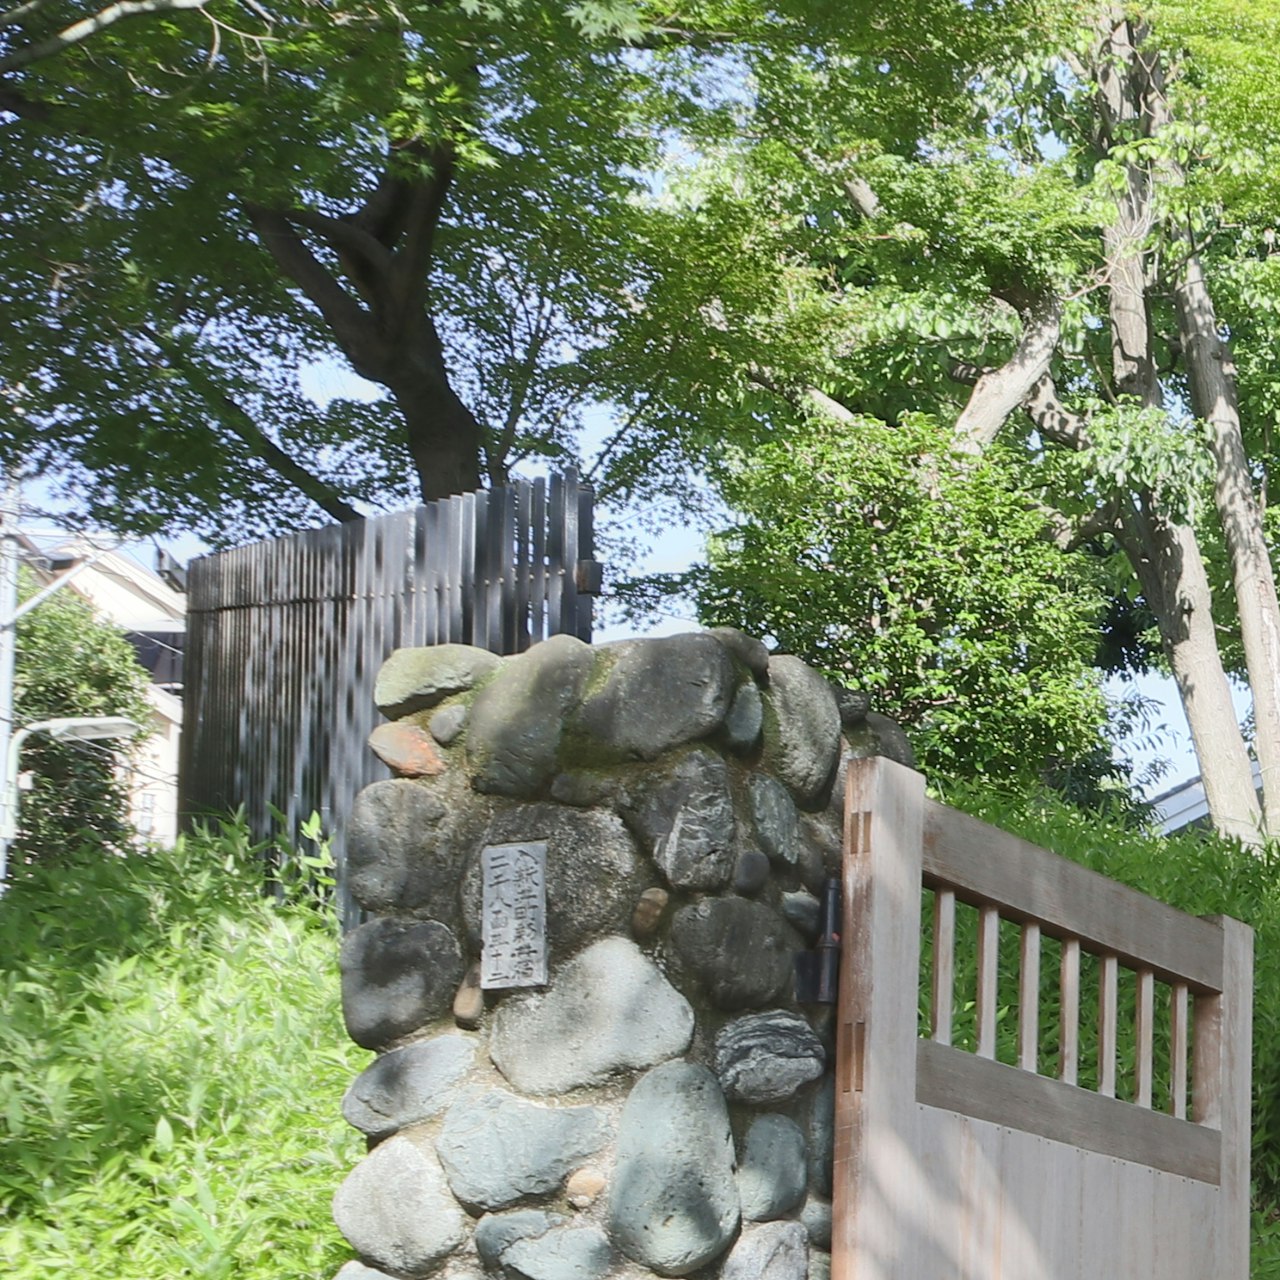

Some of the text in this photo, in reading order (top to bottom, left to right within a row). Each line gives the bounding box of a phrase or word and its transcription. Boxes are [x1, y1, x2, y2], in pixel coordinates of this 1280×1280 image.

[488, 855, 512, 982] 二千八百三十二
